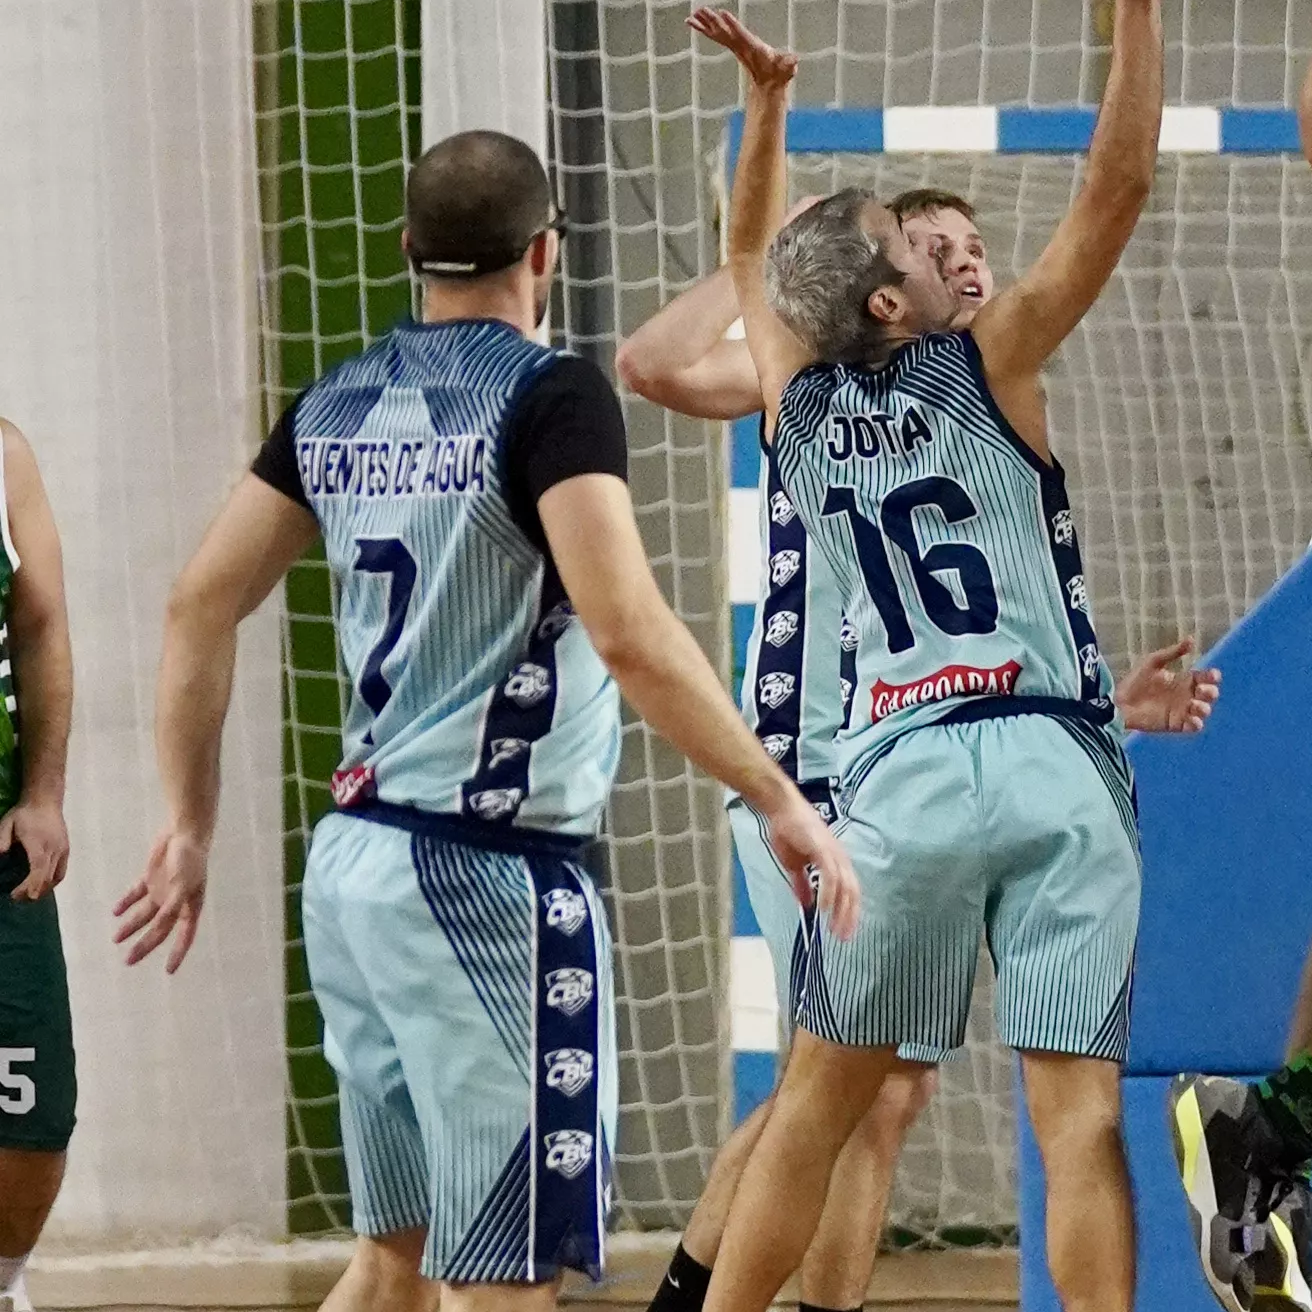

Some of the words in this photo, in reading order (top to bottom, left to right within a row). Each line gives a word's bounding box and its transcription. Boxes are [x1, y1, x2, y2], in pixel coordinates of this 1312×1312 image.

[422, 439, 485, 493] AGUA
[828, 406, 933, 461] JOTA
[820, 475, 1000, 655] 16
[354, 538, 417, 746] 7
